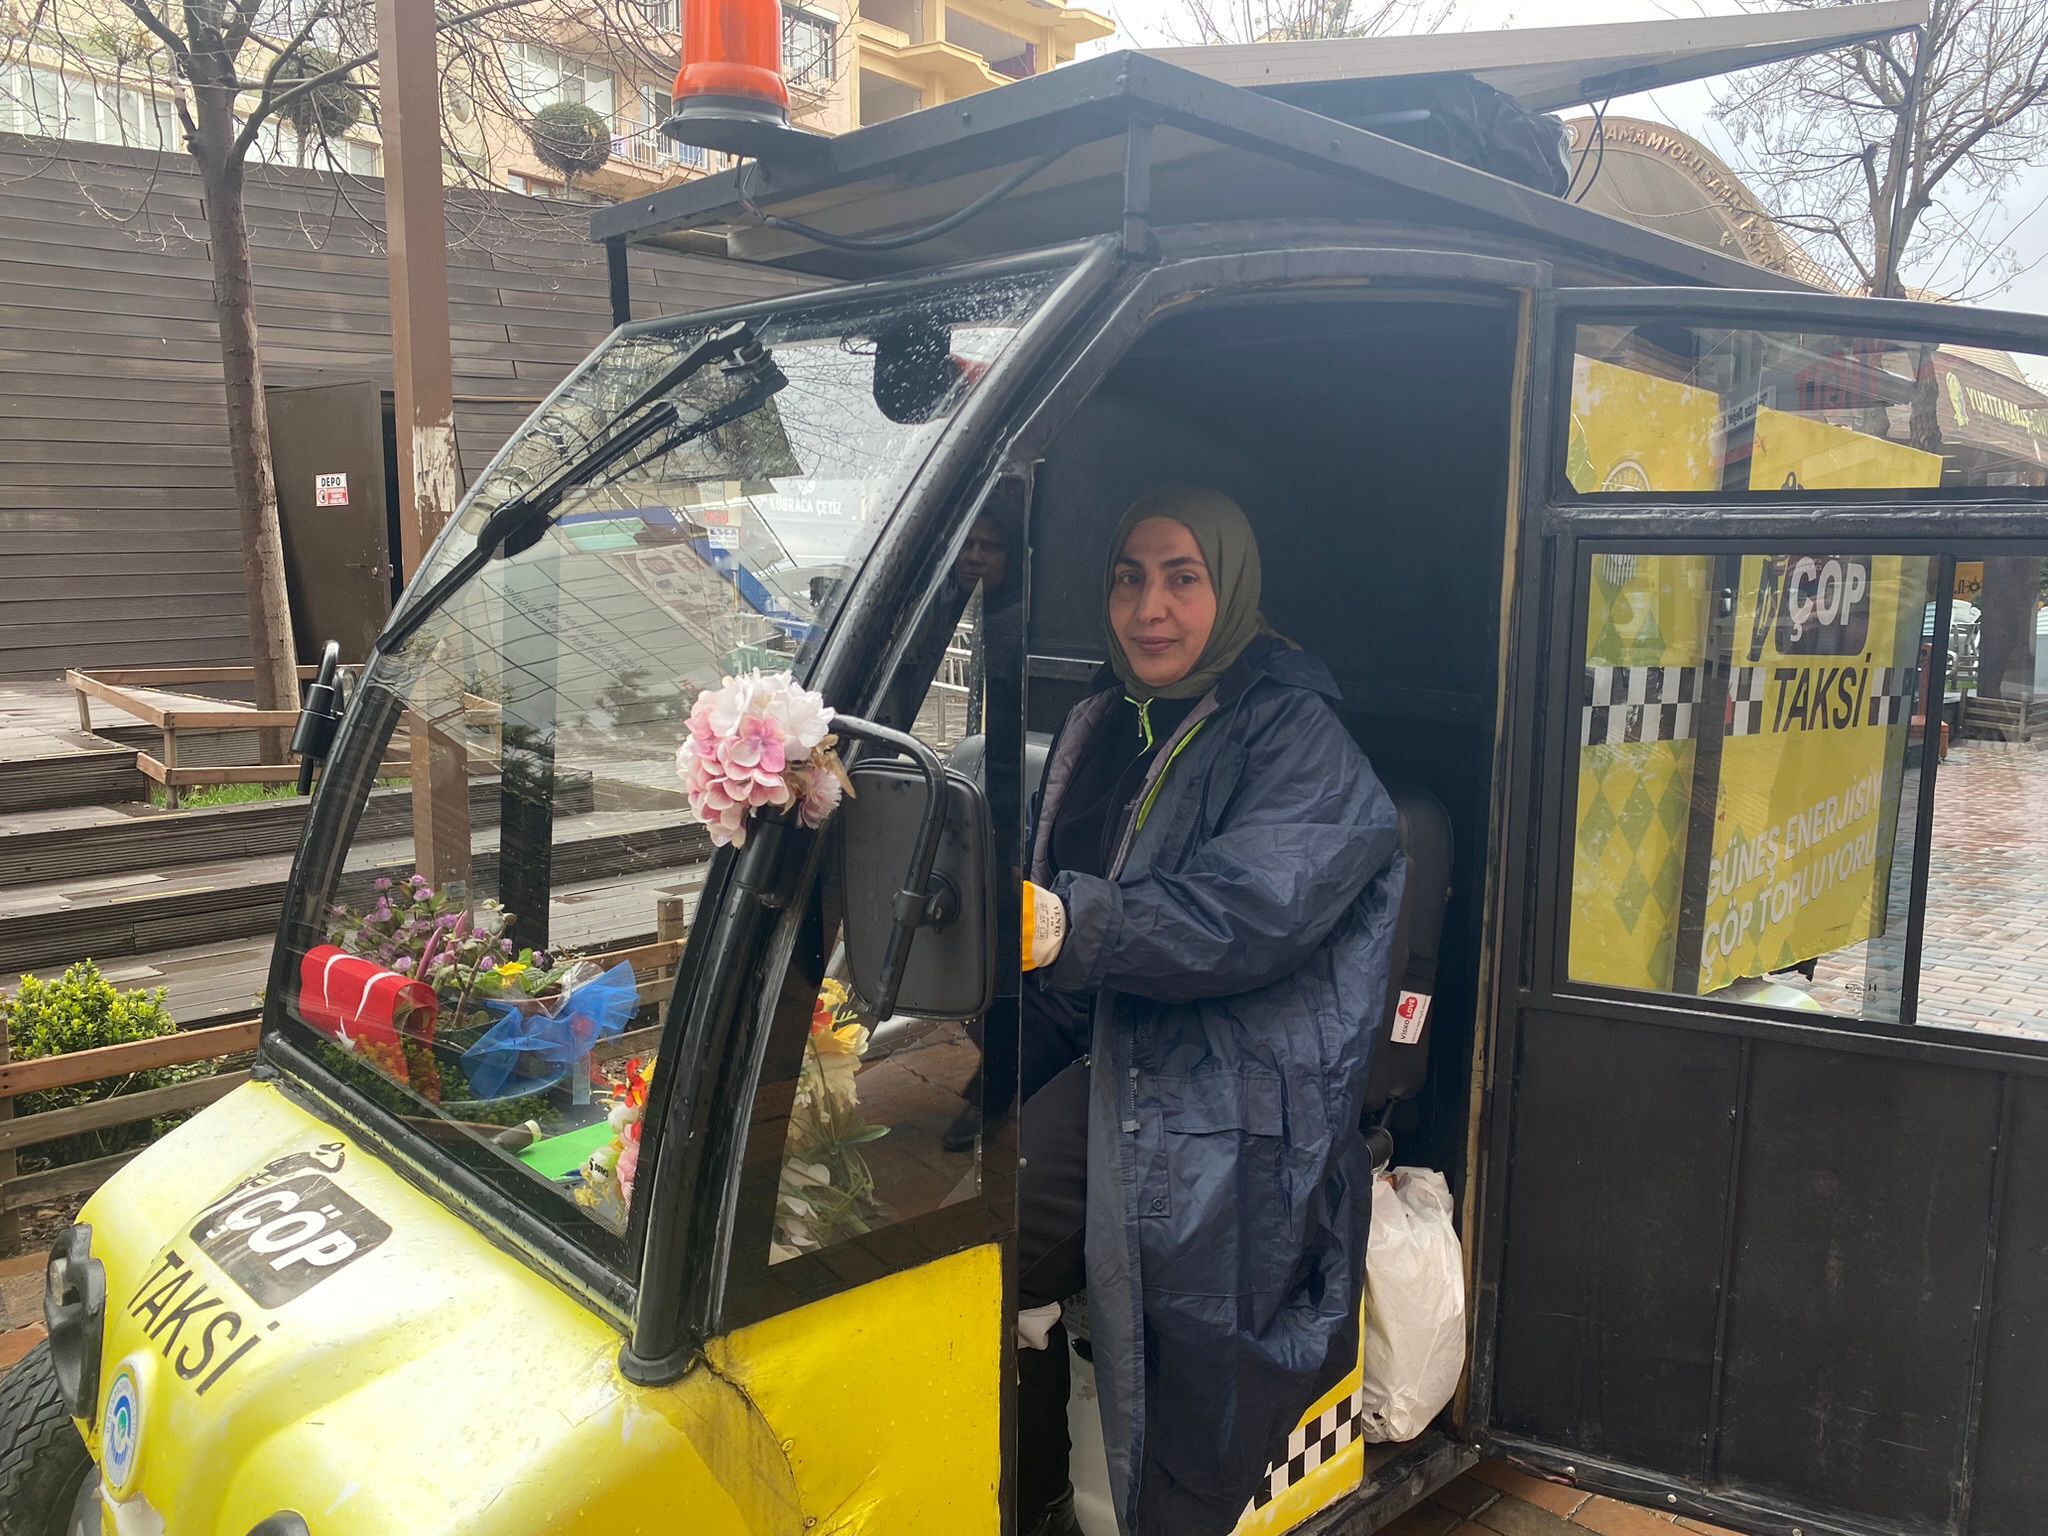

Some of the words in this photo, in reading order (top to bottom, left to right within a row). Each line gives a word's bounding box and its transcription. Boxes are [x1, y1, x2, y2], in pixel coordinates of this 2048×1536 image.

[320, 476, 341, 487] DEPO
[1788, 554, 1867, 642] ÇÖP
[1772, 652, 1872, 733] TAKSİ
[1706, 825, 1781, 907] GÜNEŞ
[1701, 897, 1754, 985] ÇÖP
[205, 1190, 358, 1273] ÇÖP
[127, 1249, 281, 1397] TAKSİ
